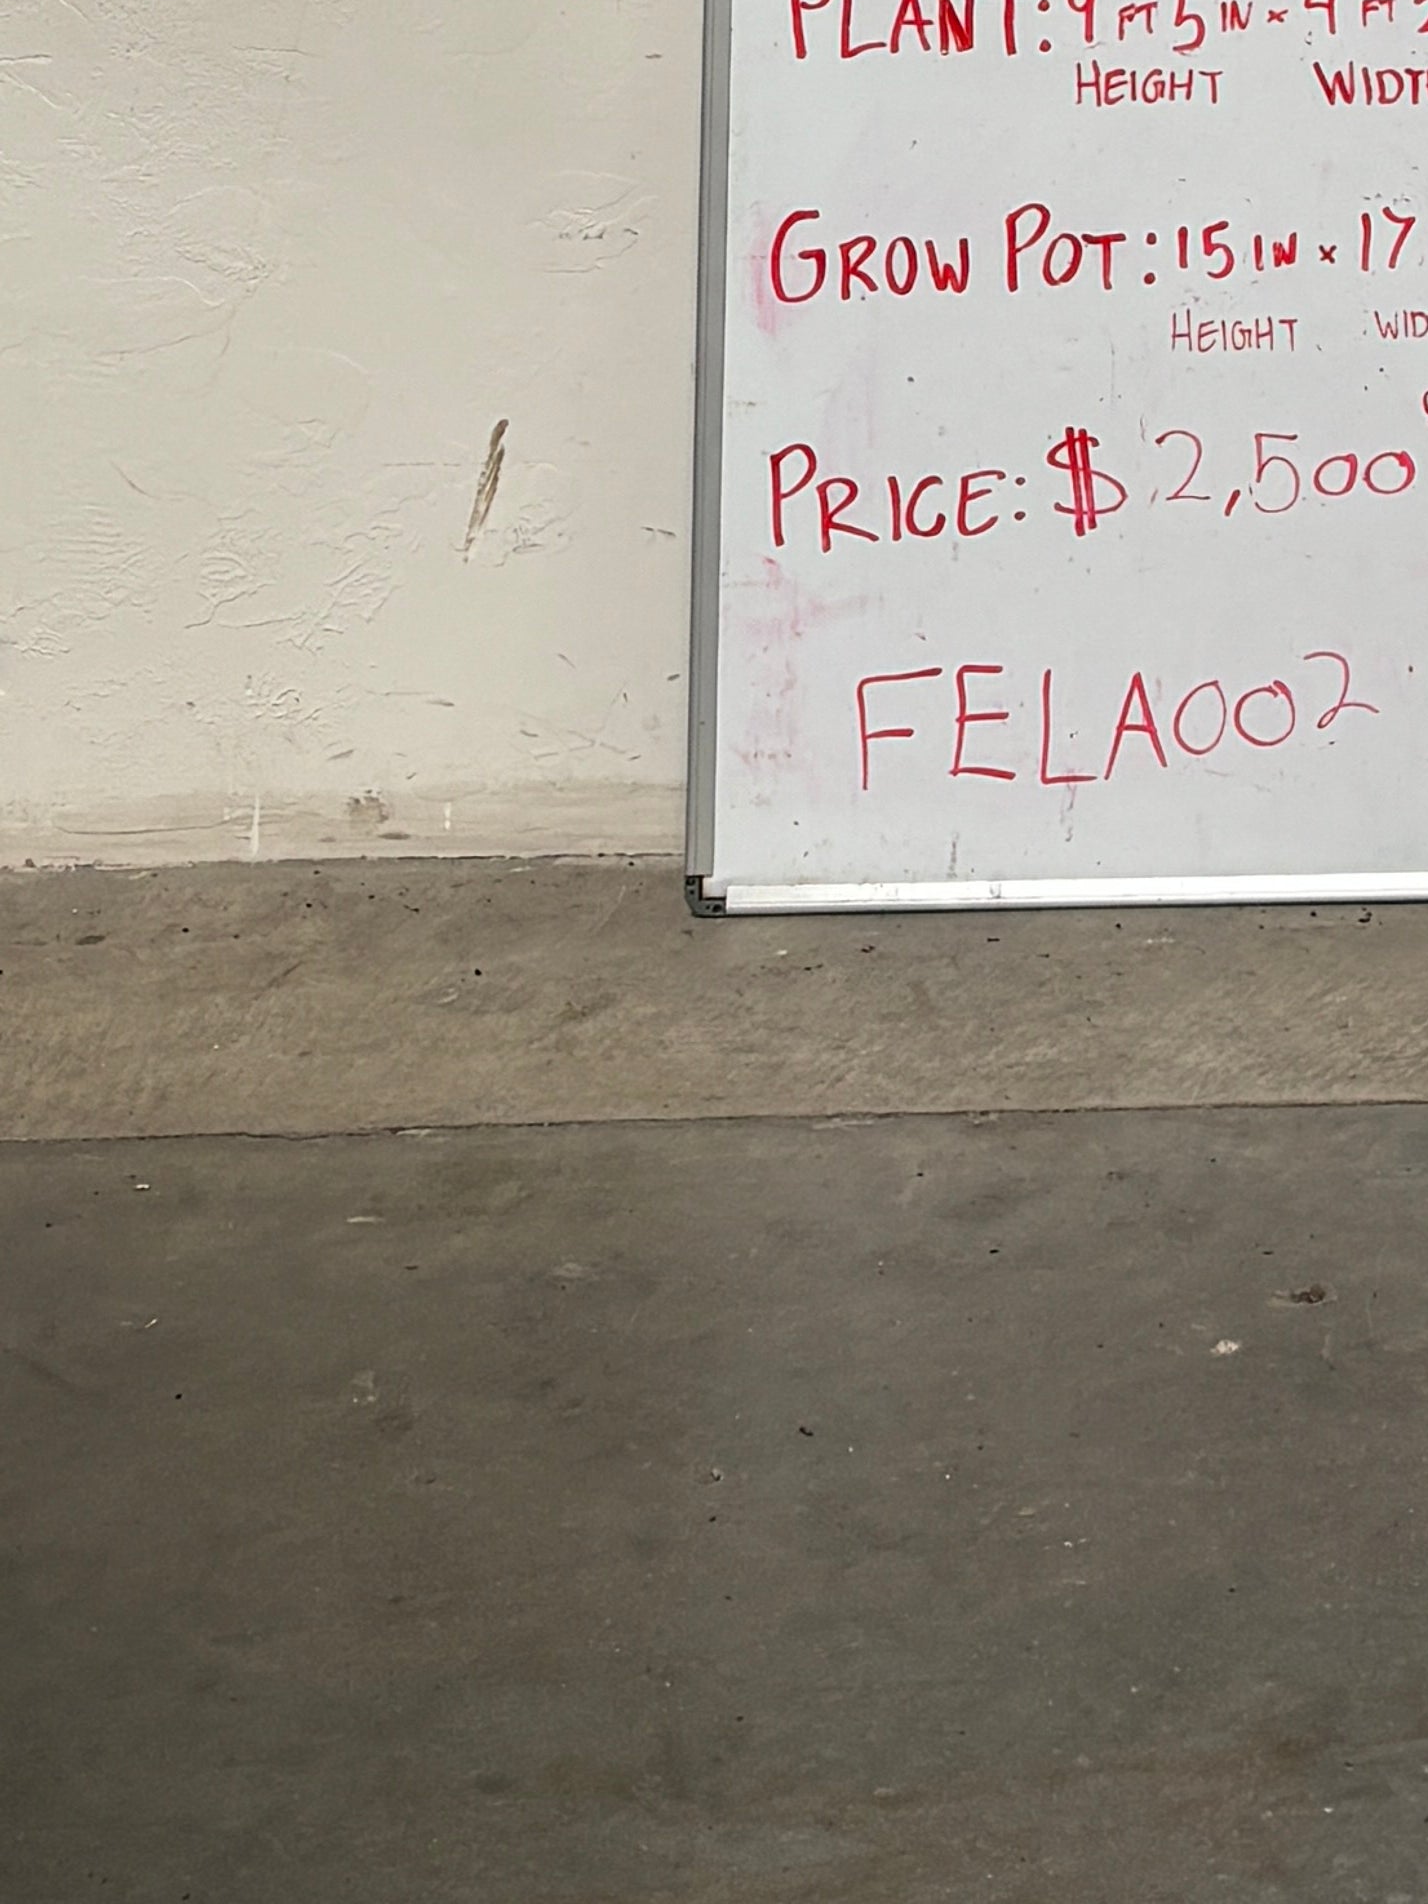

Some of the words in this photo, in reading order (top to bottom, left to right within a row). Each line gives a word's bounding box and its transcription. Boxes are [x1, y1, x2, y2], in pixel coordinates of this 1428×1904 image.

[1116, 0, 1158, 41] FT
[1219, 0, 1251, 33] IN
[1075, 61, 1220, 107] HEIGHT
[768, 209, 970, 305] GROW
[1003, 203, 1157, 294] POT:
[1176, 220, 1236, 281] 15
[1252, 232, 1298, 273] IN
[1359, 207, 1416, 273] 17
[1170, 313, 1299, 354] HEIGHT
[768, 443, 1024, 554] PRICE:
